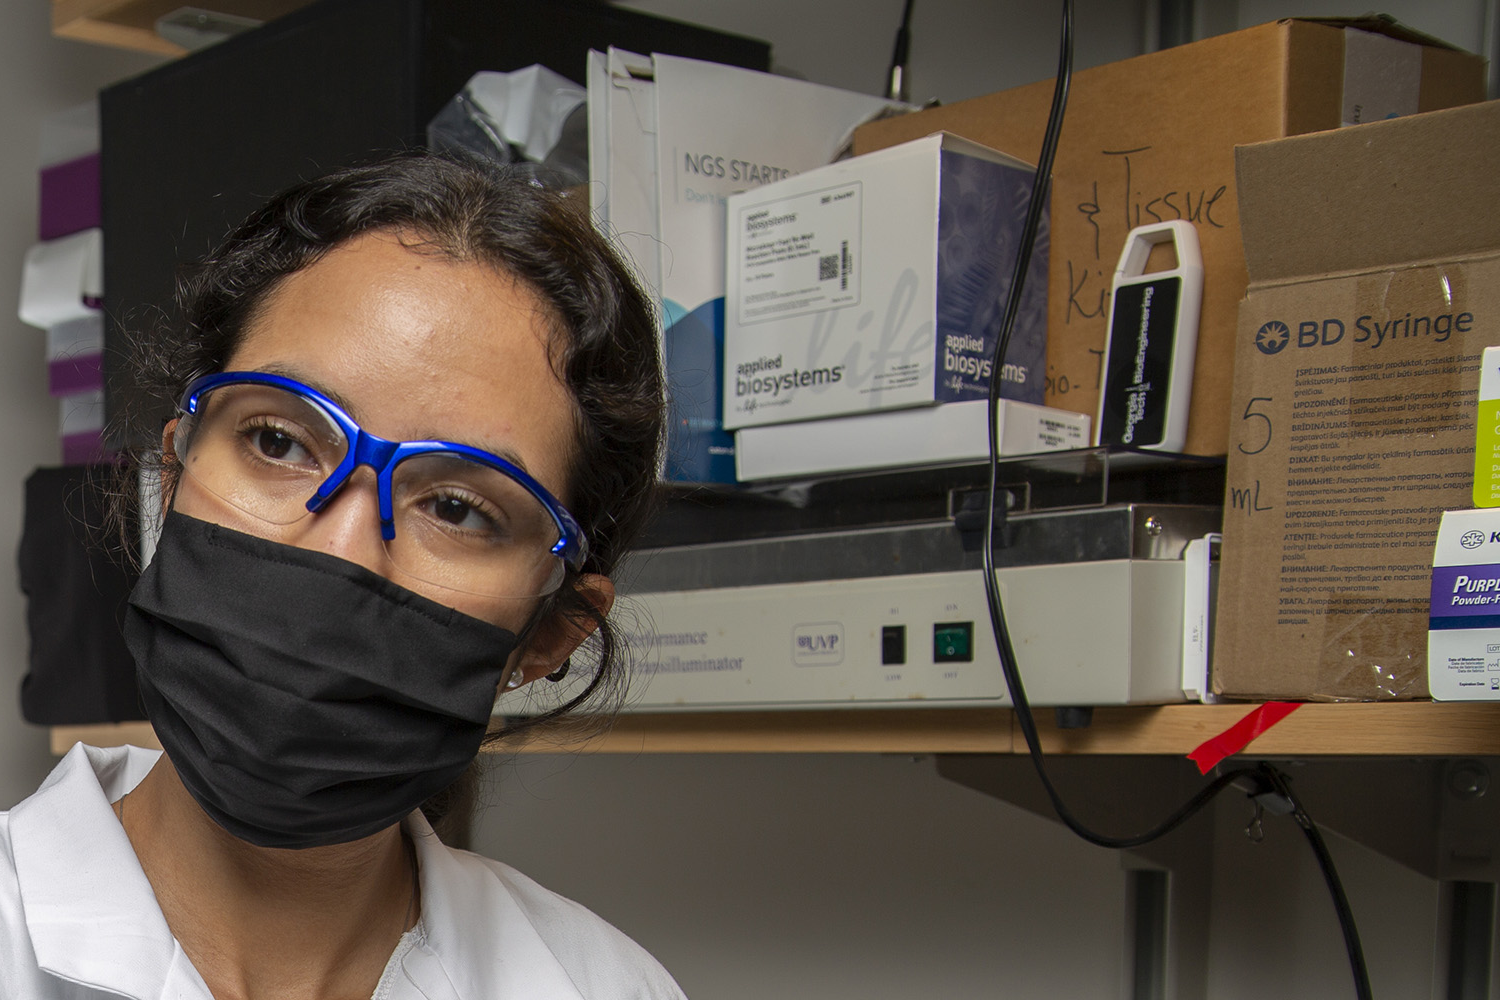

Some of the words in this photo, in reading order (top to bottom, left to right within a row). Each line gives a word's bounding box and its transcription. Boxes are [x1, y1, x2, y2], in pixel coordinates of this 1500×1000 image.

[684, 151, 725, 178] NGS
[1102, 145, 1227, 230] Tissue
[1066, 260, 1112, 325] Ki
[945, 333, 984, 353] applied
[1298, 318, 1346, 348] BD
[1354, 311, 1474, 349] Syringe
[736, 364, 843, 397] biosystems
[737, 353, 783, 377] applied
[944, 347, 1026, 384] biosysms
[1238, 397, 1273, 455] 5
[1288, 466, 1313, 474] hemen
[1289, 455, 1319, 464] DIKKAT:
[1321, 454, 1330, 462] Bu
[1231, 480, 1273, 517] mL
[1287, 477, 1335, 487] ВНИМАНИЕ:
